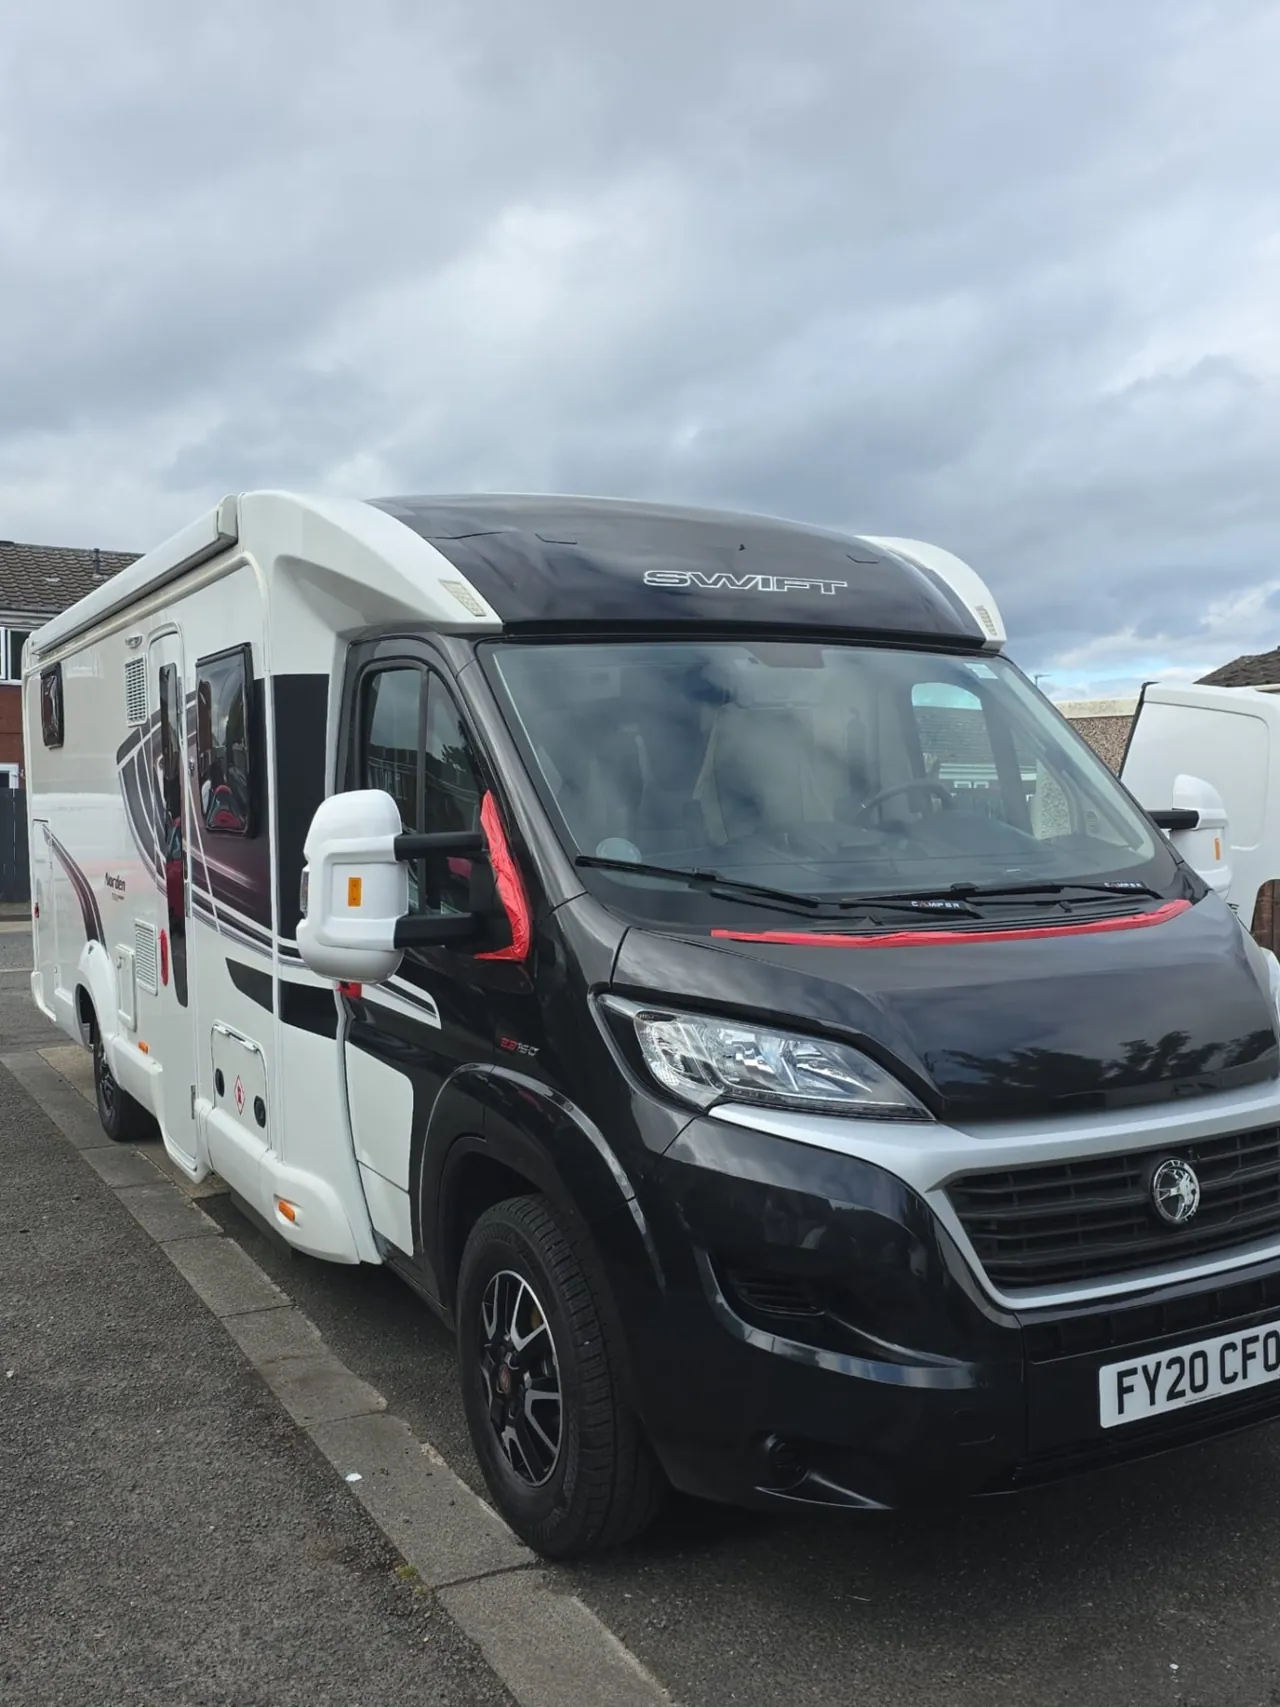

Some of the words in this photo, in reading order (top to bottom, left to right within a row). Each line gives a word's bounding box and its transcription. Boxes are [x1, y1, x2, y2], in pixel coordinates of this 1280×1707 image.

[643, 570, 848, 595] SWIFT
[1116, 1350, 1209, 1416] FY20
[1219, 1329, 1280, 1385] CFO
